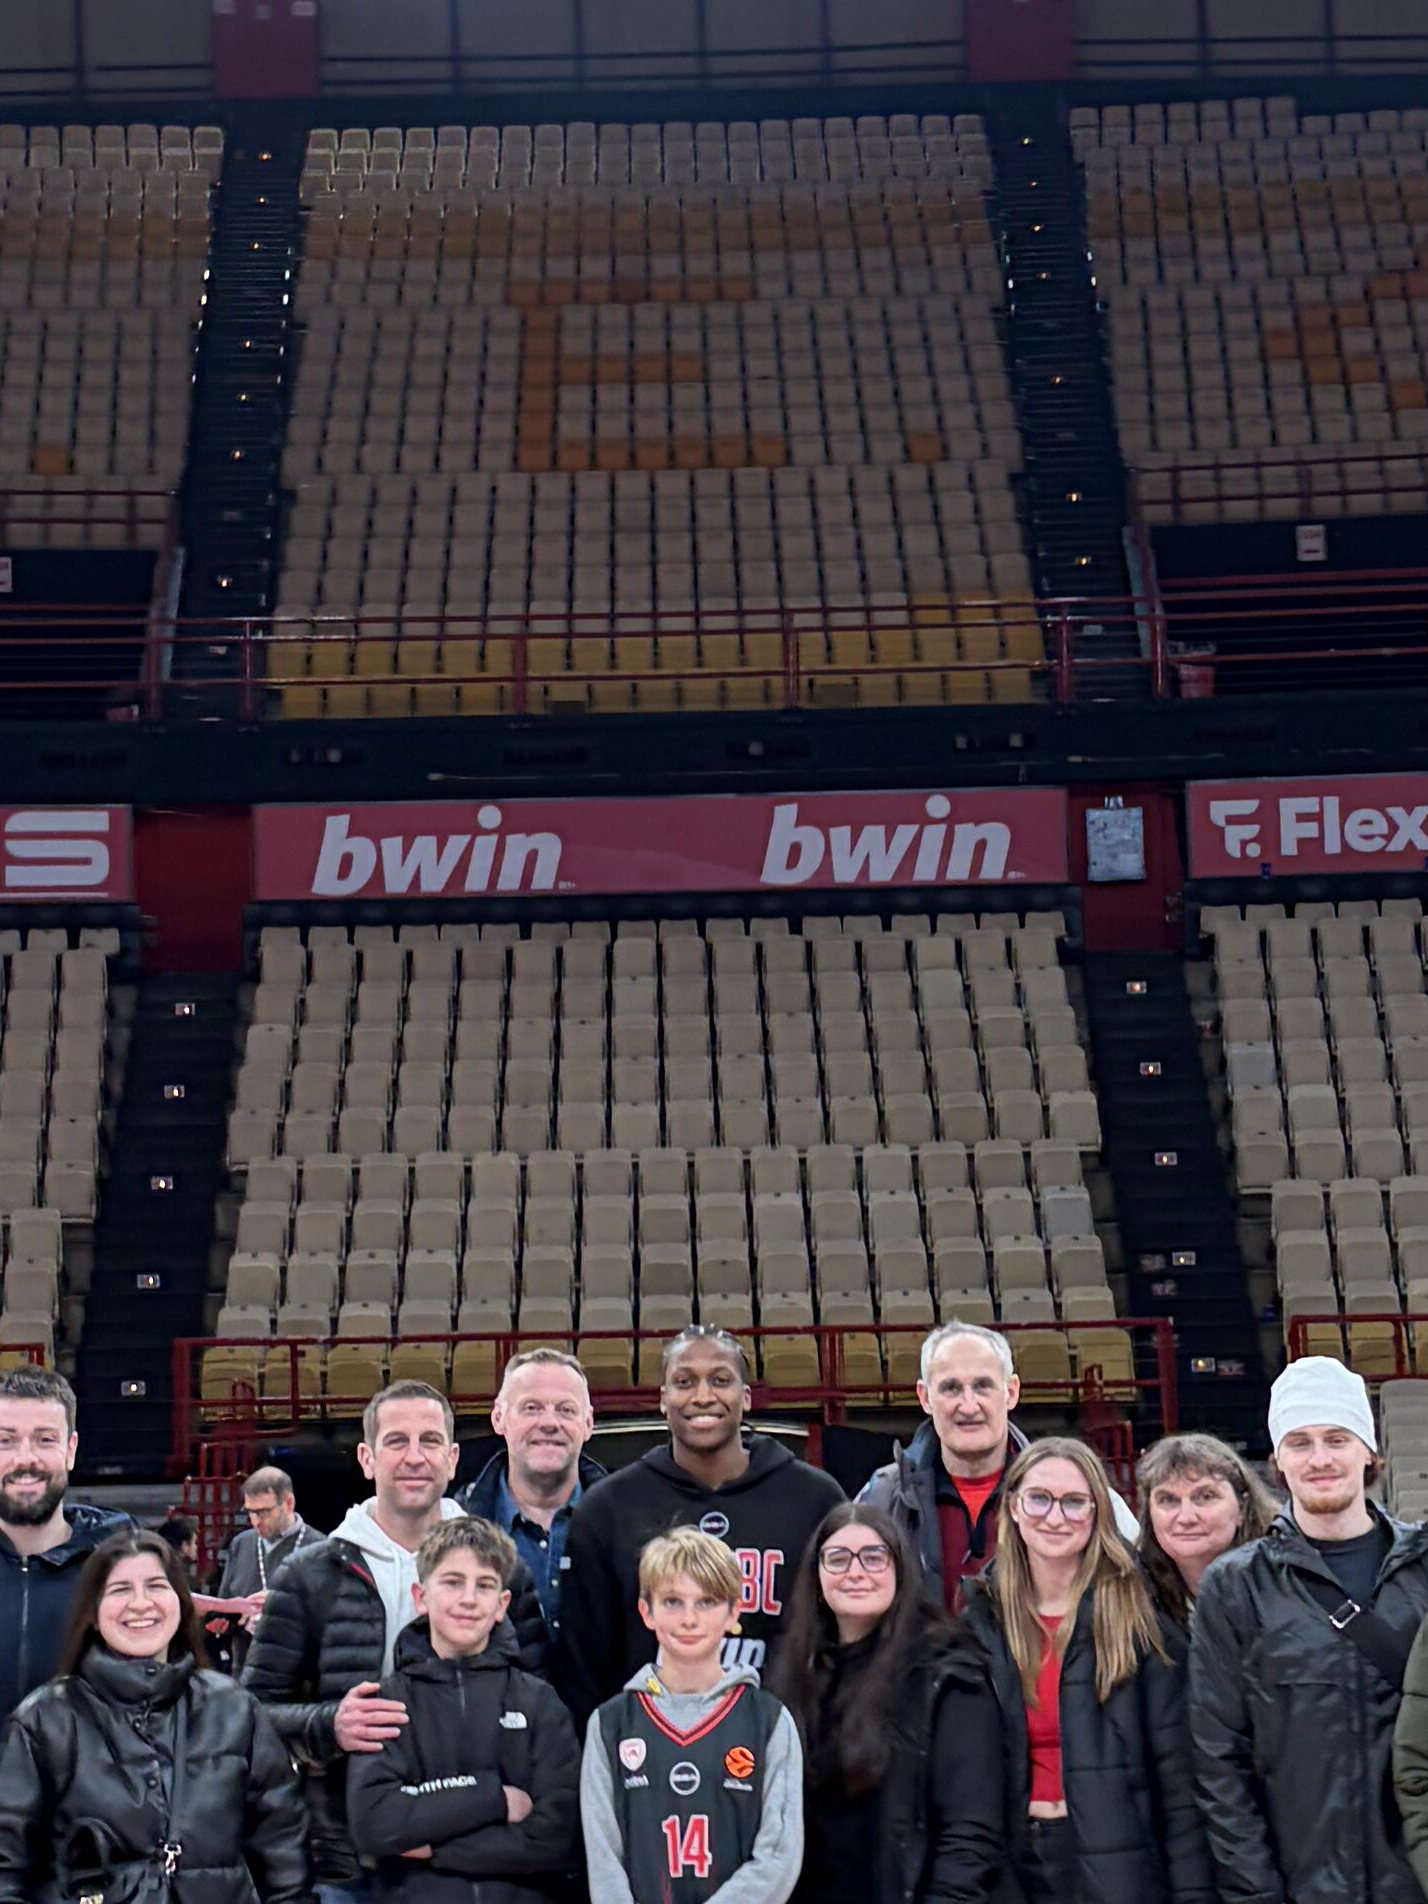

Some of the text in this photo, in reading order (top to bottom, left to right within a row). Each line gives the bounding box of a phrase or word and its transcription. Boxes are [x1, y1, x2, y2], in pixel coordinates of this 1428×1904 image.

[310, 804, 562, 894] bwin
[760, 794, 1011, 884] bwin
[662, 1814, 712, 1878] 14
